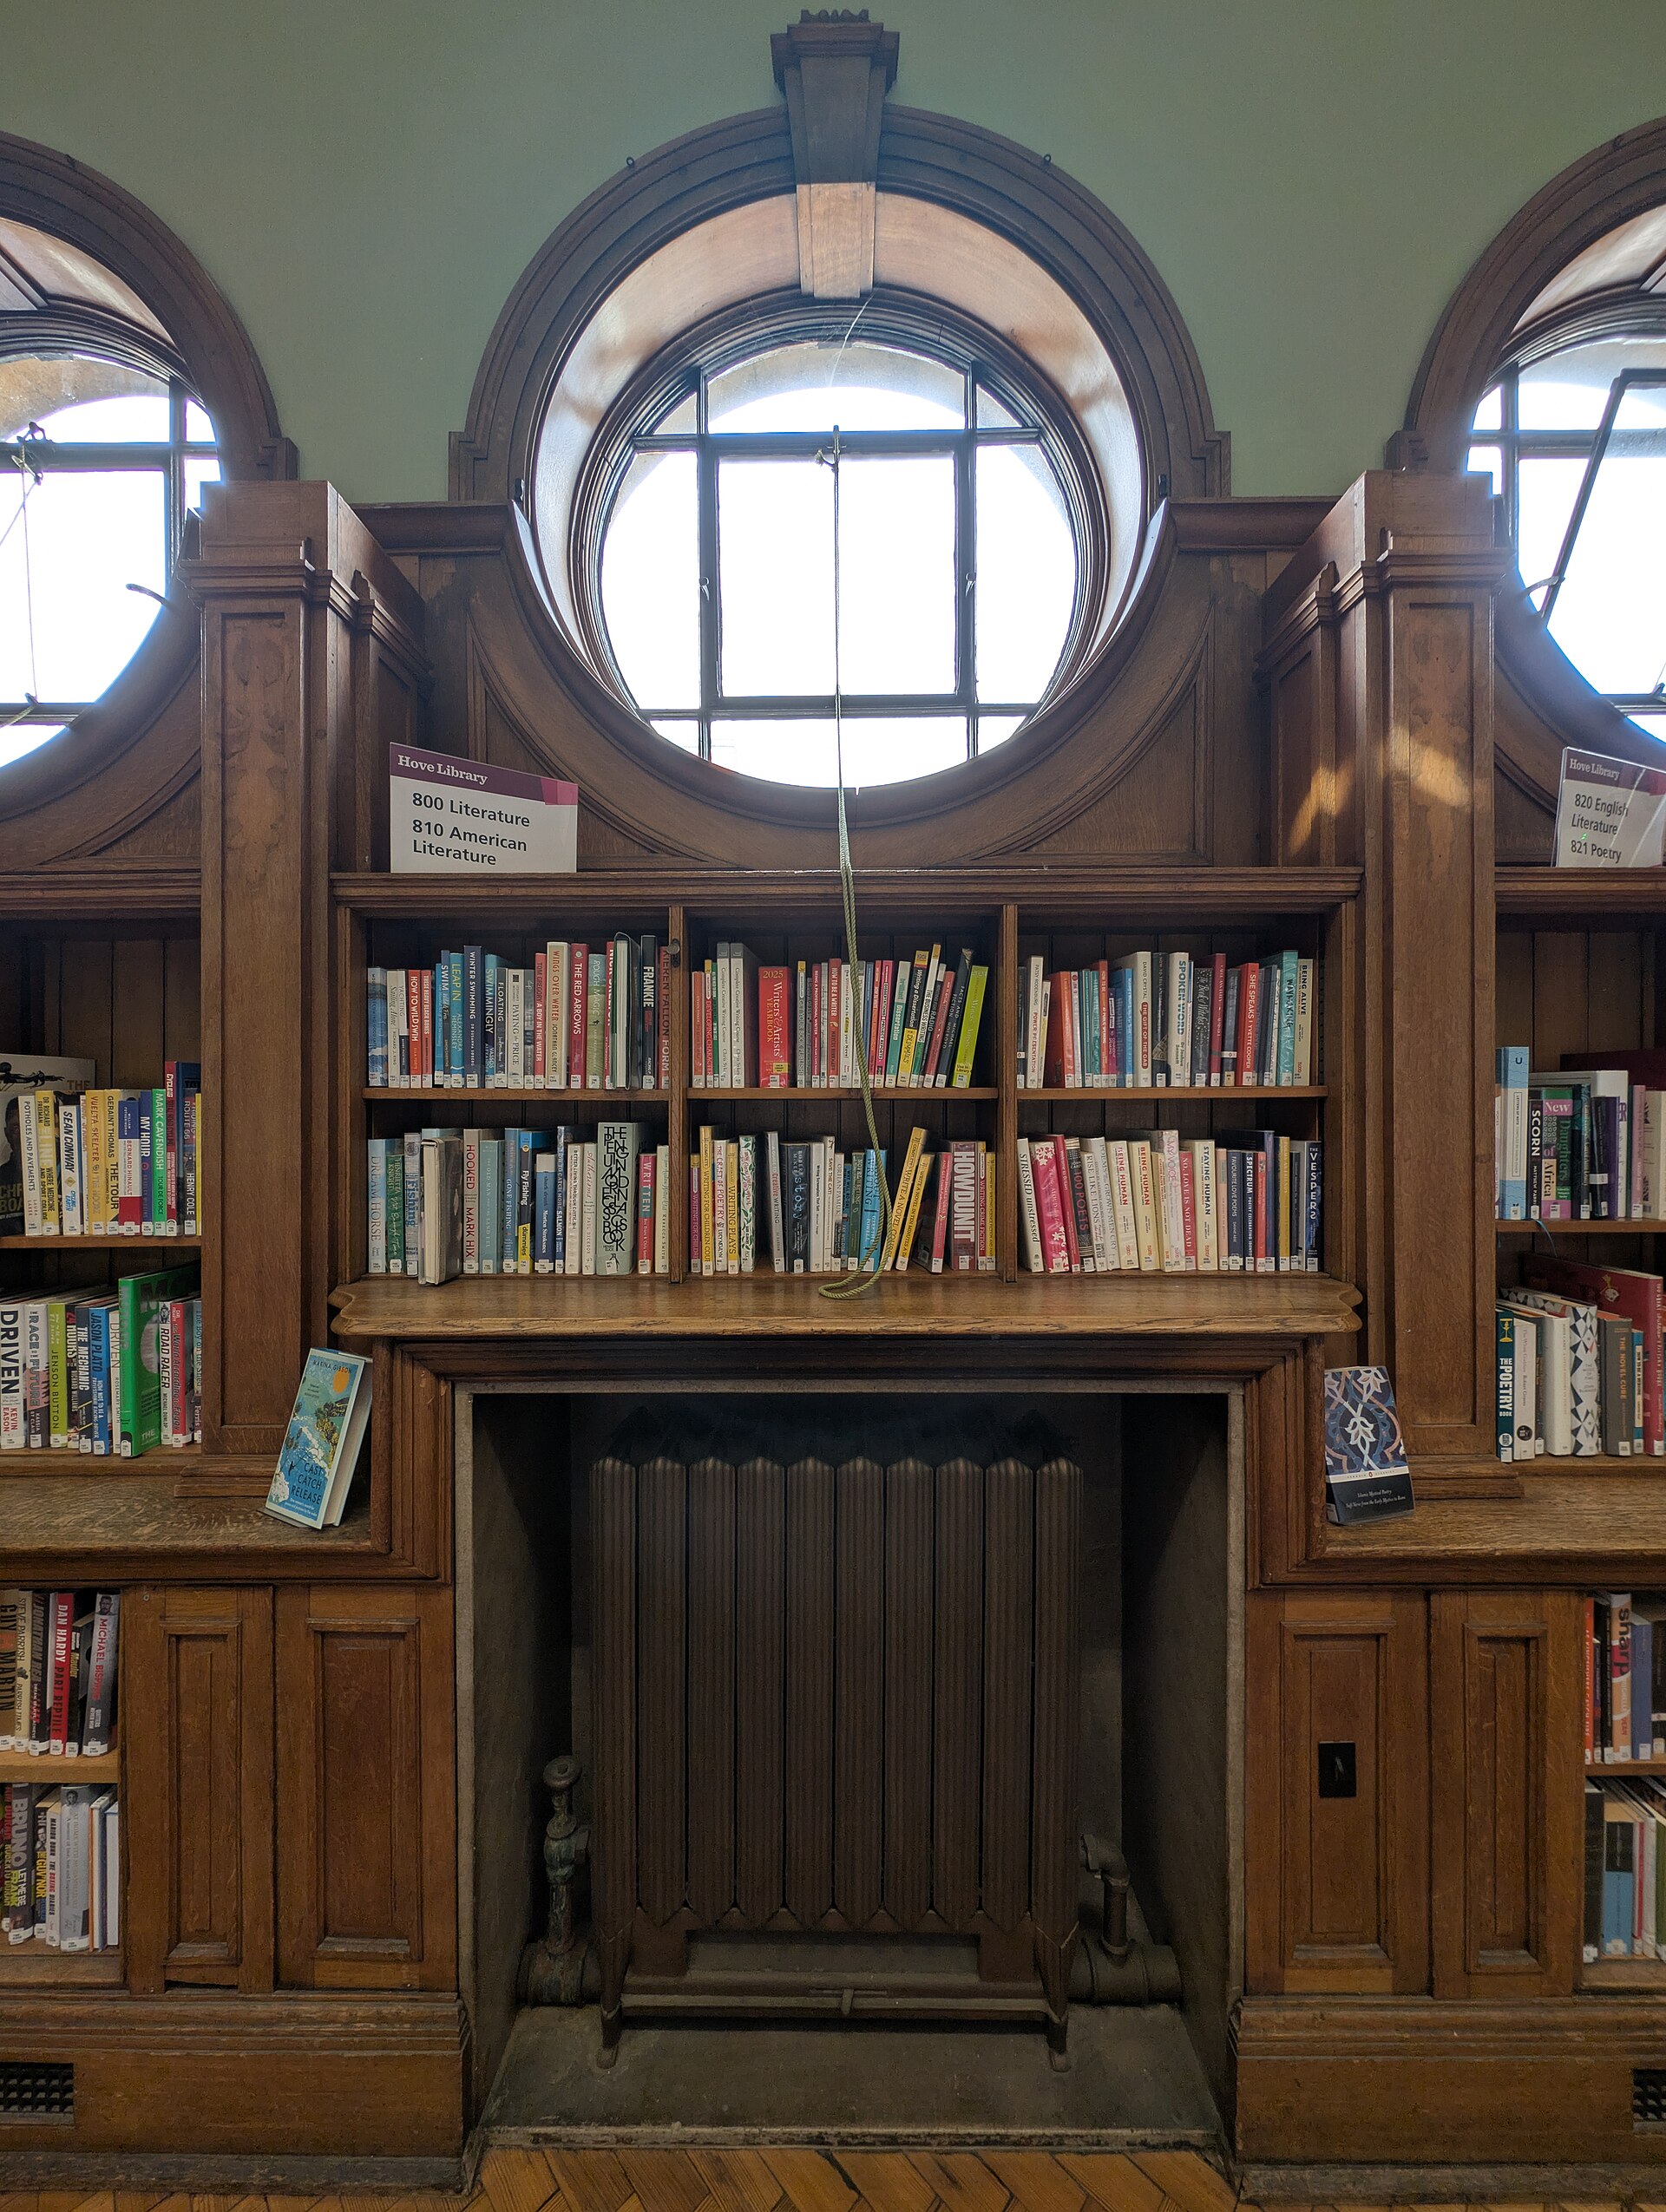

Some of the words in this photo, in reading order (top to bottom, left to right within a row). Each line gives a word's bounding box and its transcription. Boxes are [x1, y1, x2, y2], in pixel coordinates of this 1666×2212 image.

[397, 755, 435, 772] Hove
[436, 763, 488, 785] Library
[1570, 758, 1590, 772] Hove
[1591, 763, 1620, 781] Library
[412, 792, 443, 810] 800
[450, 800, 530, 827] Literature
[1575, 794, 1592, 809] 820
[1595, 798, 1629, 817] English
[412, 820, 443, 836] 810
[449, 827, 527, 851] American
[1571, 814, 1618, 834] Literature
[413, 840, 496, 865] Literature
[1571, 840, 1587, 854] 821
[1591, 844, 1622, 863] Poetry
[452, 964, 461, 989] LEAP
[644, 966, 654, 1008] FRANKIE
[913, 969, 923, 989] Writing
[389, 985, 397, 1007] Sailing
[411, 995, 417, 1005] TO
[452, 990, 461, 1000] IN
[773, 982, 782, 1018] Writers'
[908, 994, 920, 1028] Dissertation
[928, 1011, 936, 1031] RADIO
[773, 1026, 782, 1058] Artists'
[24, 1101, 33, 1135] POTHOLES
[63, 1111, 74, 1135] SEAN
[140, 1116, 149, 1130] MY
[1531, 1110, 1541, 1156] SCORN
[64, 1136, 75, 1173] CONWAY
[140, 1132, 150, 1157] HOUR
[155, 1121, 164, 1170] CAVENDISH
[1557, 1120, 1570, 1181] Daughters
[371, 1156, 381, 1198] DREAM
[642, 1162, 651, 1212] WRITTEN
[1020, 1154, 1033, 1195] STRESSED
[1544, 1162, 1555, 1197] Africa
[110, 1183, 119, 1209] TOUR
[187, 1197, 195, 1214] COLE
[521, 1181, 529, 1206] Fishing
[793, 1176, 804, 1220] story
[954, 1151, 974, 1242] HOWDUNIT
[371, 1201, 381, 1241] HORSE
[466, 1207, 475, 1236] MARK
[1026, 1197, 1040, 1242] unstressed
[1076, 1192, 1088, 1231] POETS
[466, 1240, 475, 1258] HIX
[77, 1326, 89, 1344] THE
[91, 1312, 102, 1342] JASON
[0, 1310, 19, 1394] DRIVEN
[91, 1344, 102, 1372] PLATO
[78, 1346, 89, 1391] MECHANIC
[1499, 1367, 1512, 1410] POETRY
[298, 1475, 322, 1490] CATCH
[304, 1462, 324, 1476] CAST
[292, 1485, 321, 1504] RELEASE
[56, 1605, 68, 1626] DAN
[55, 1628, 67, 1663] HARDY
[95, 1618, 108, 1662] MICHAEL
[10, 1797, 29, 1867] BRUNO
[36, 1859, 46, 1898] GUV'NOR
